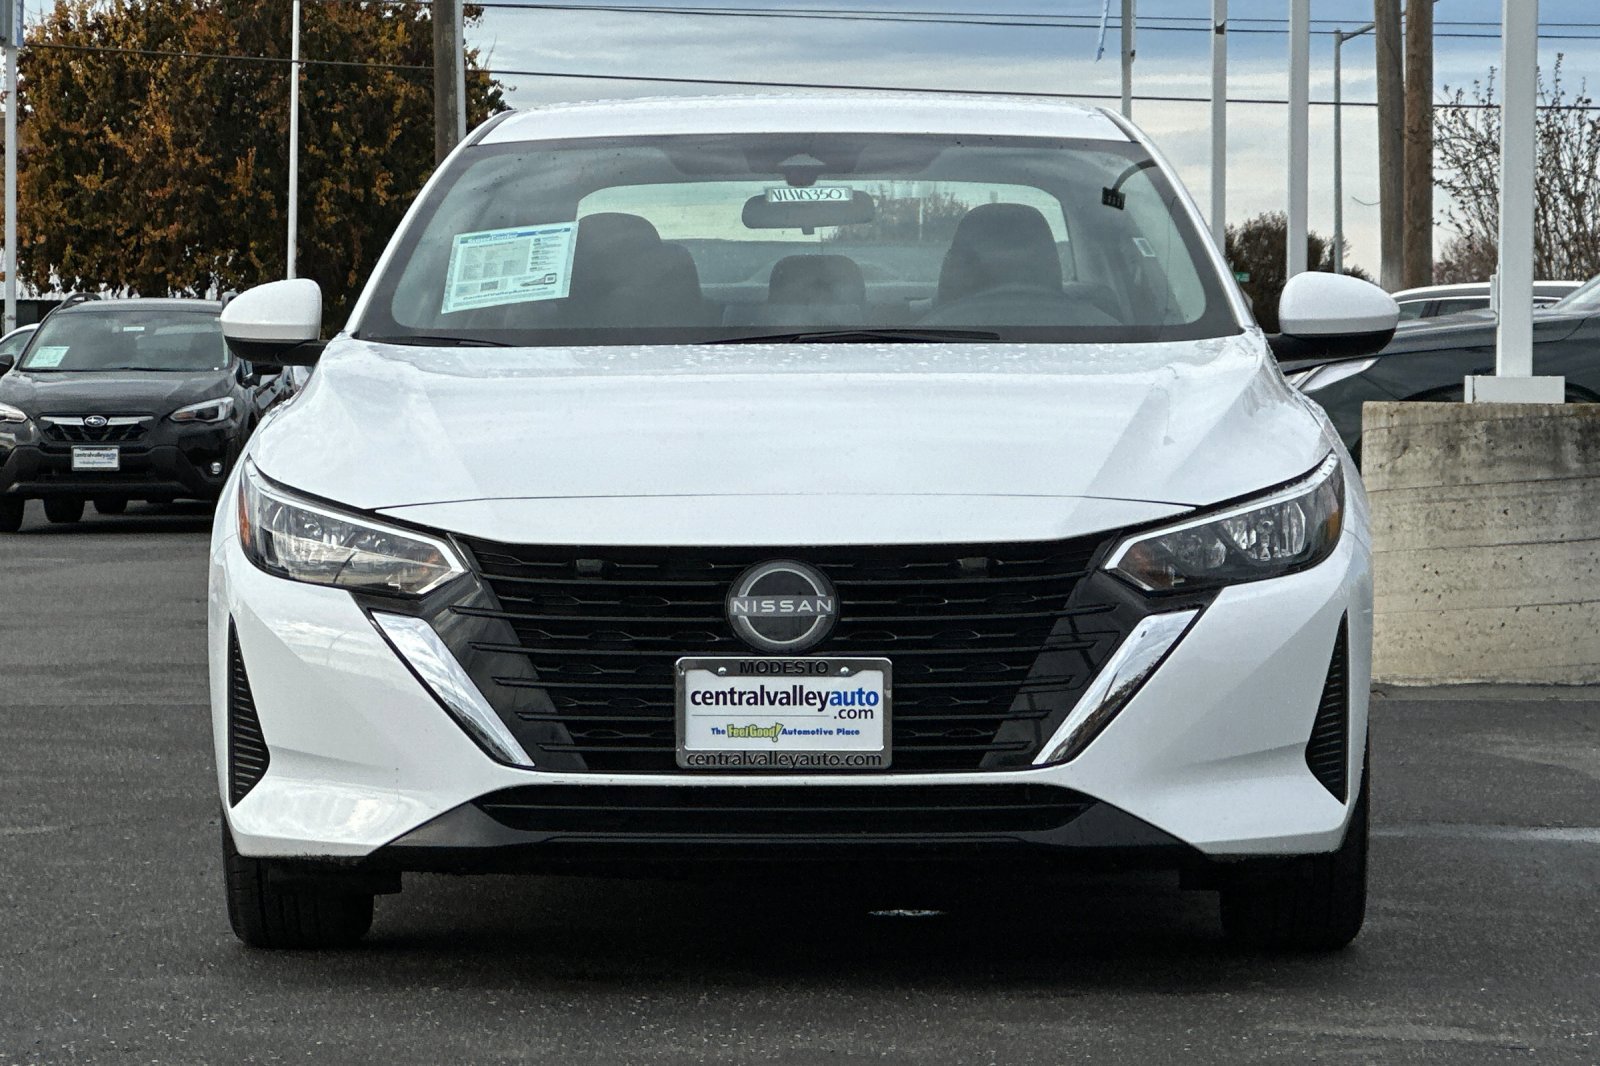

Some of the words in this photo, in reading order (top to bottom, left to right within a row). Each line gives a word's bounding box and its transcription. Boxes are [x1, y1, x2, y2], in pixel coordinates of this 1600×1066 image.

[733, 599, 832, 613] NISSAN
[739, 660, 829, 675] MODESTO
[690, 684, 880, 712] centralvalleyauto
[833, 708, 874, 720] .com
[711, 727, 726, 735] The
[781, 727, 834, 736] Automotive
[836, 727, 860, 736] Place
[687, 750, 882, 769] centralvalleyauto.com
